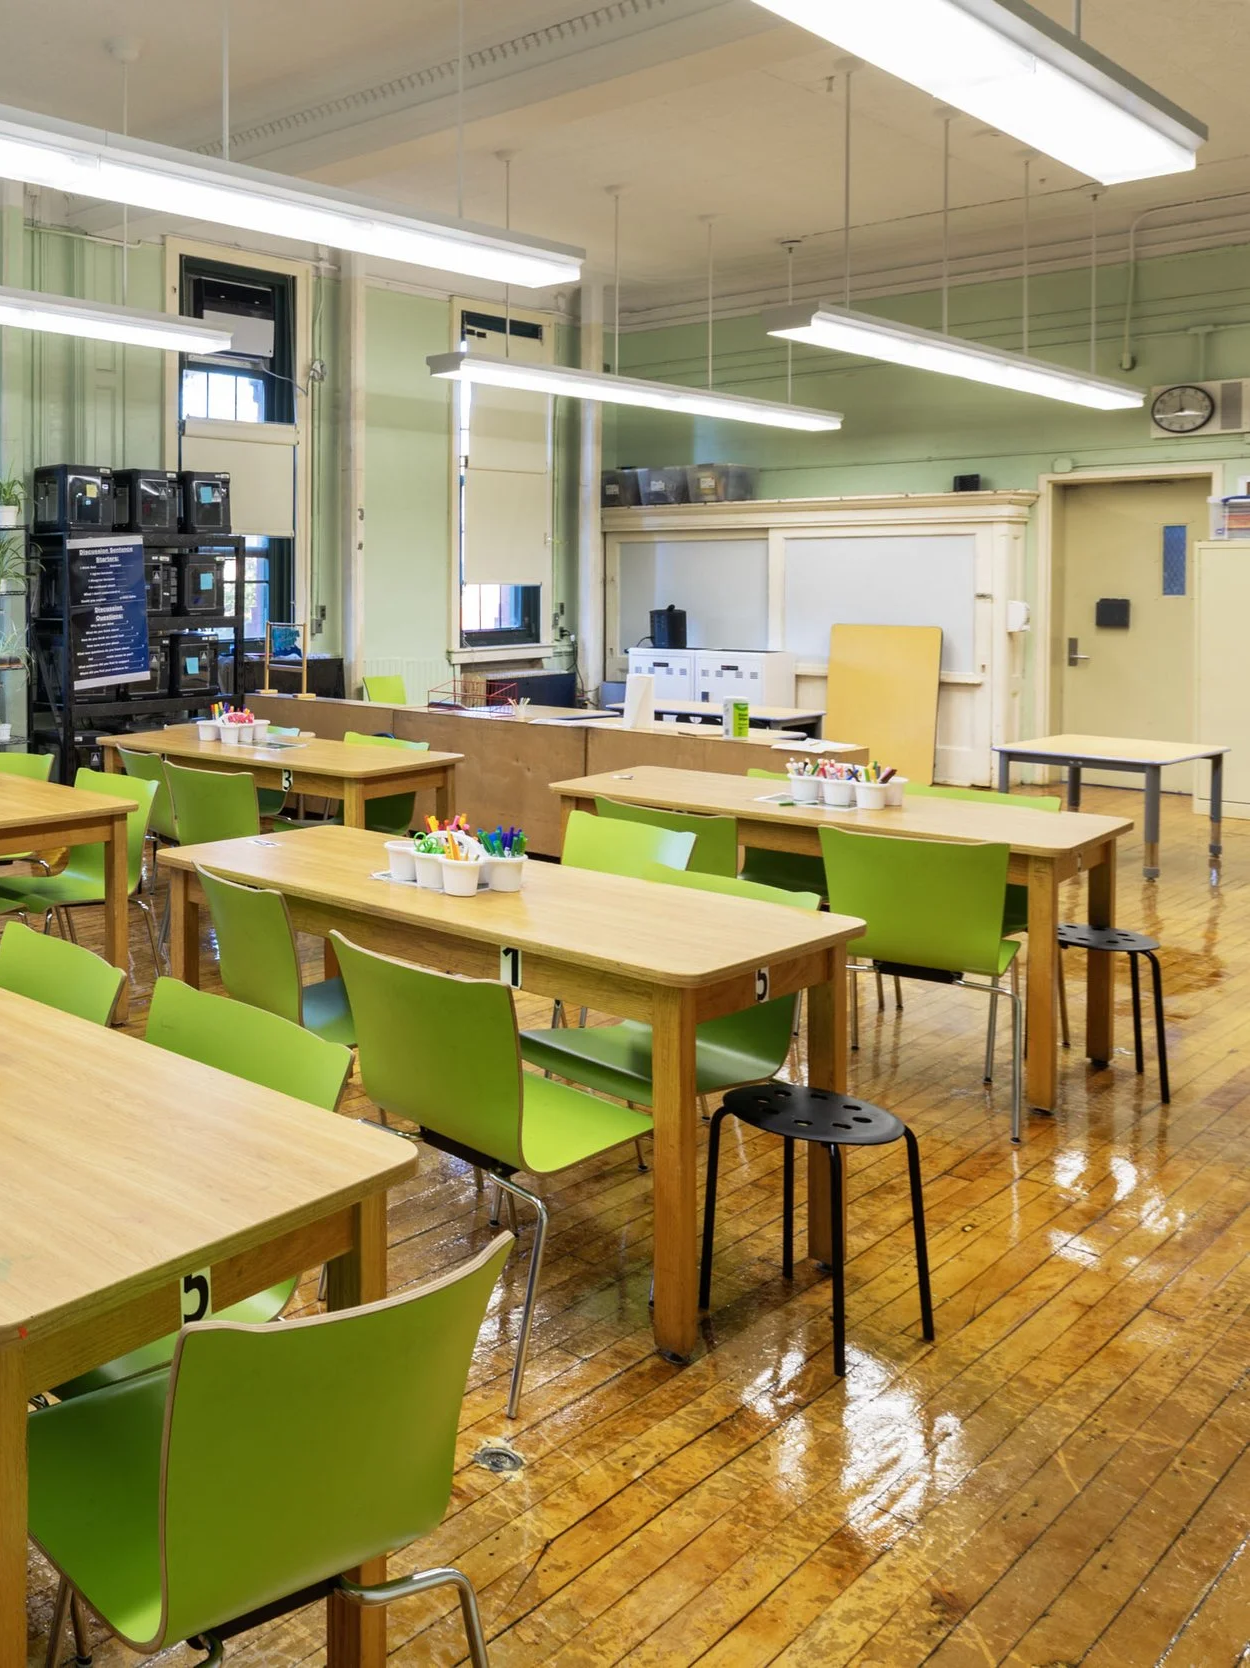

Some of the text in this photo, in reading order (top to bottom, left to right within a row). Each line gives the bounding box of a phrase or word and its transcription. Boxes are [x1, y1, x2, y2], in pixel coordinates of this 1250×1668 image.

[94, 605, 123, 613] Discussion
[283, 769, 291, 790] 3
[502, 947, 519, 987] 1
